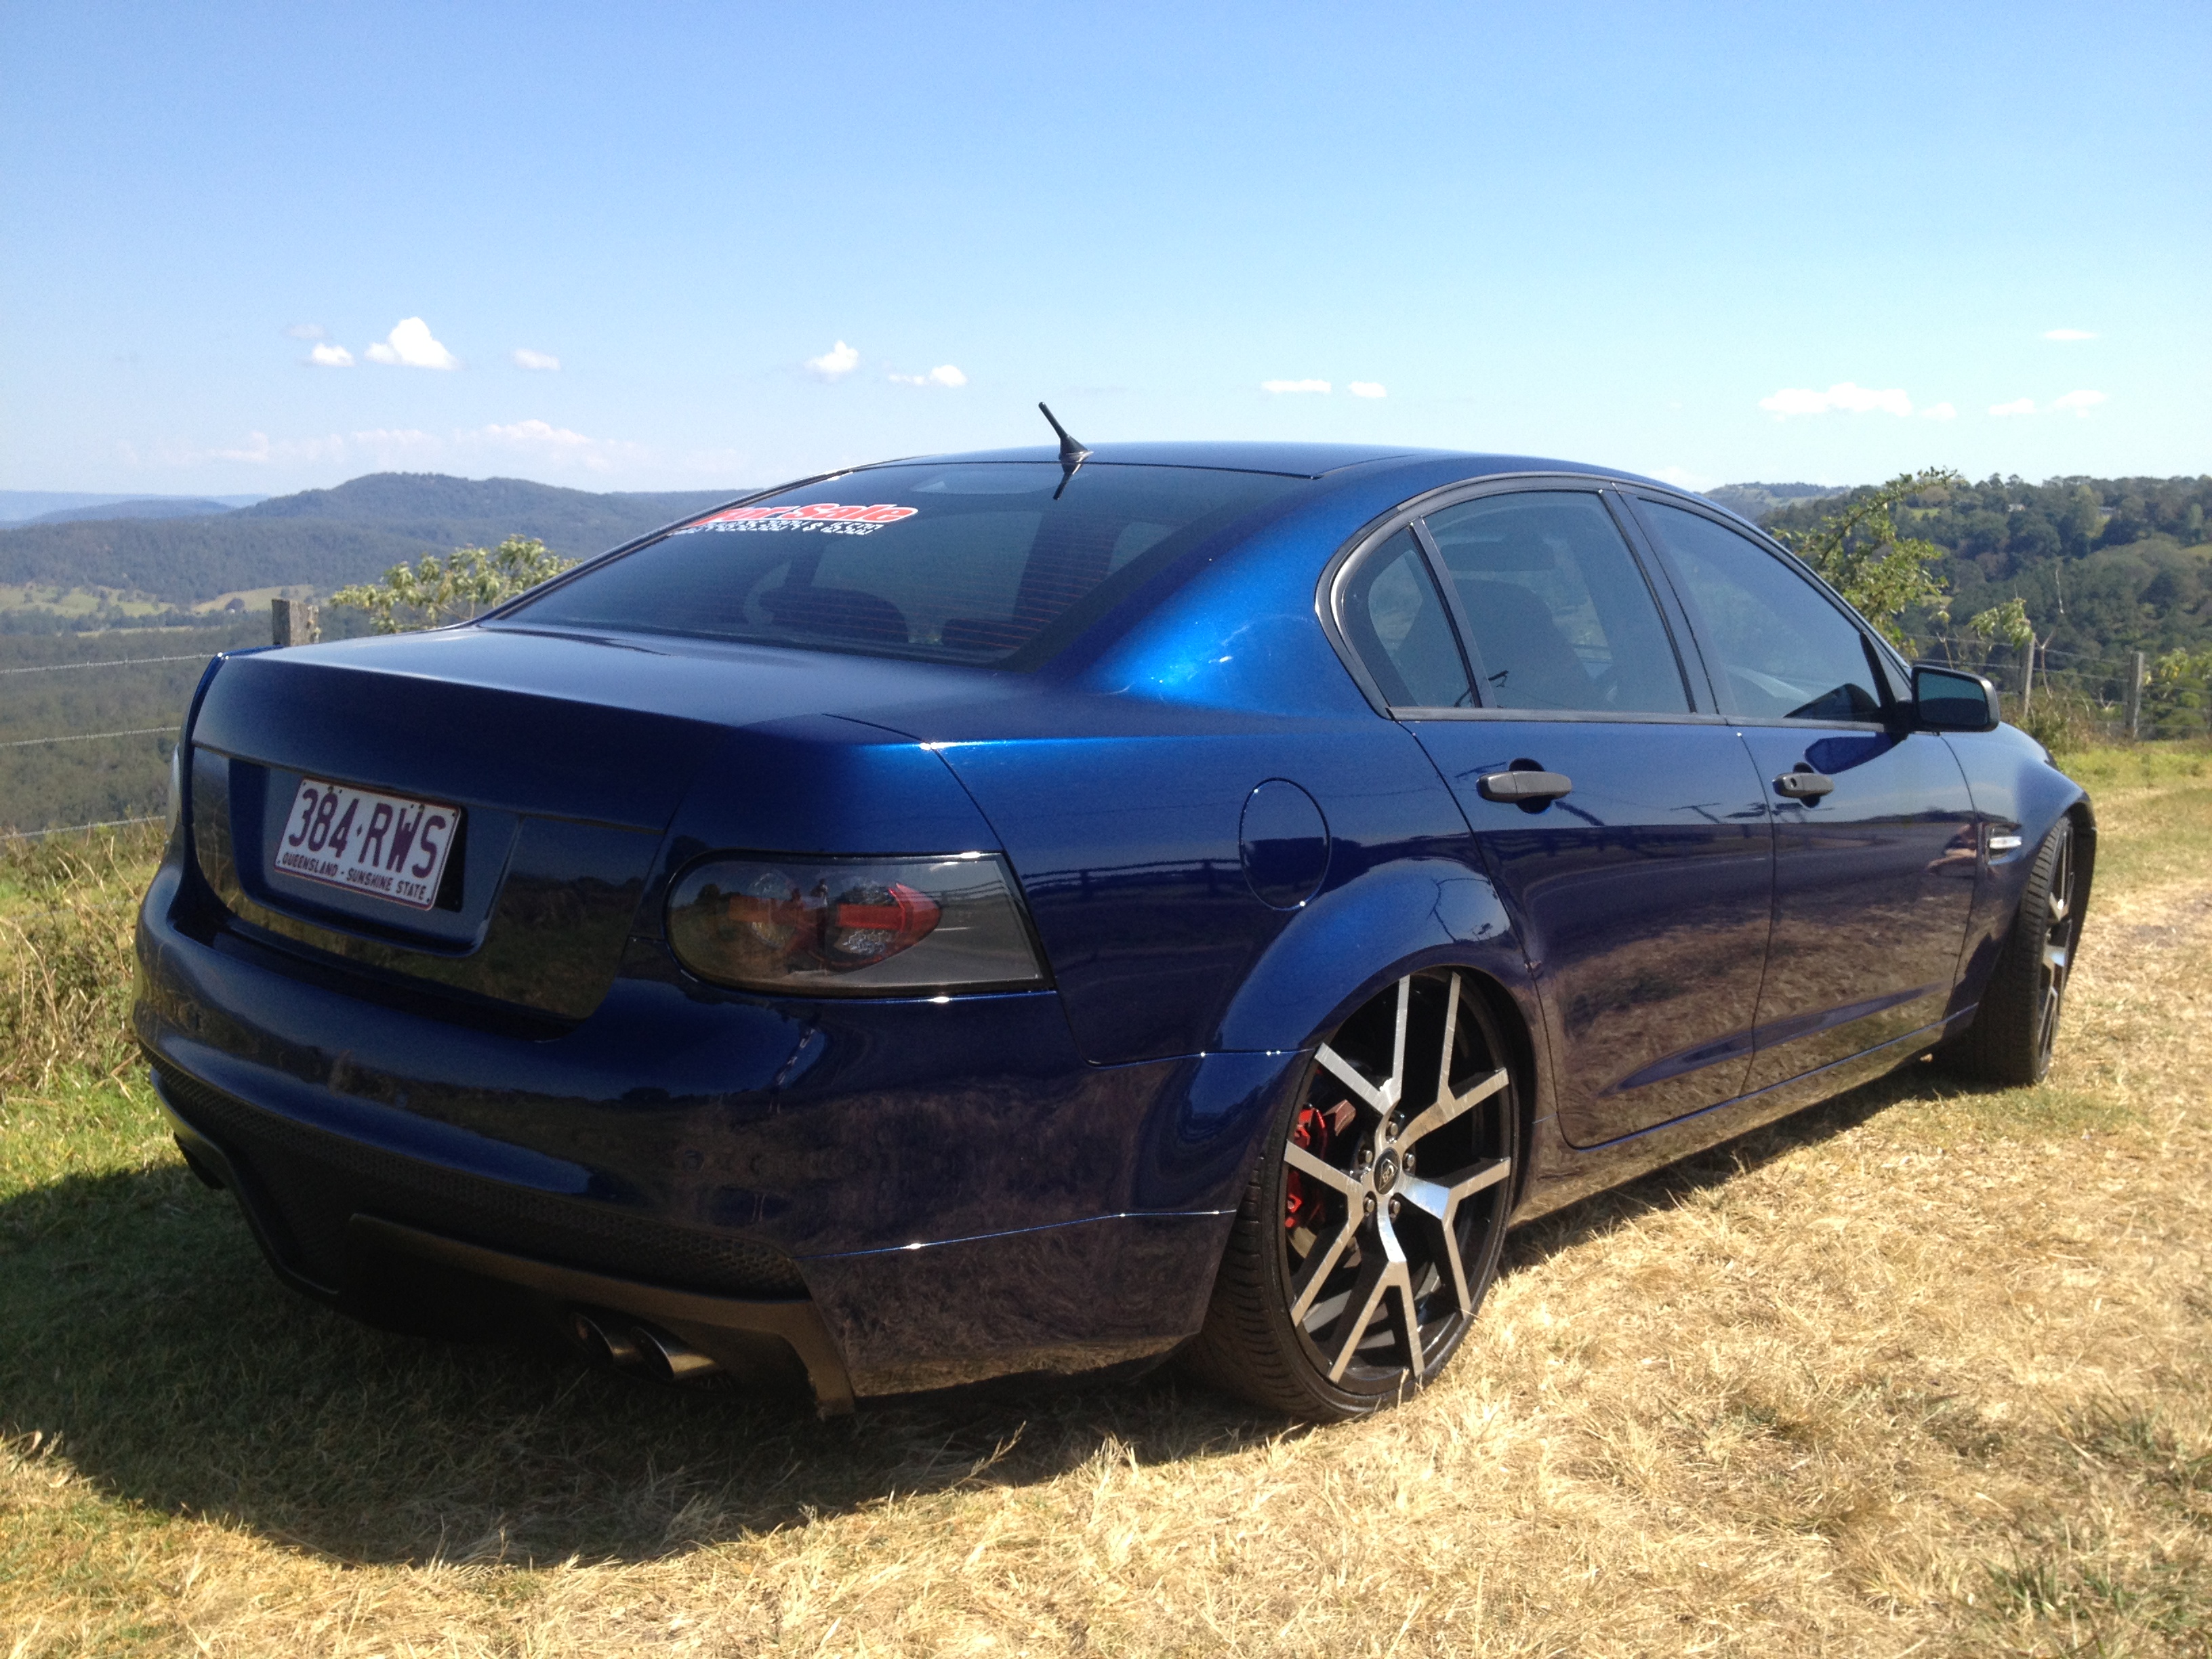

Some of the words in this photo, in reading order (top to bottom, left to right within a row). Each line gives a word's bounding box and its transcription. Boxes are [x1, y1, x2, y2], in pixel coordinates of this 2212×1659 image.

[778, 503, 918, 523] Sale
[282, 852, 338, 877] QUEENSLAND
[346, 867, 394, 892] SUNSHINE
[396, 880, 427, 901] STATE
